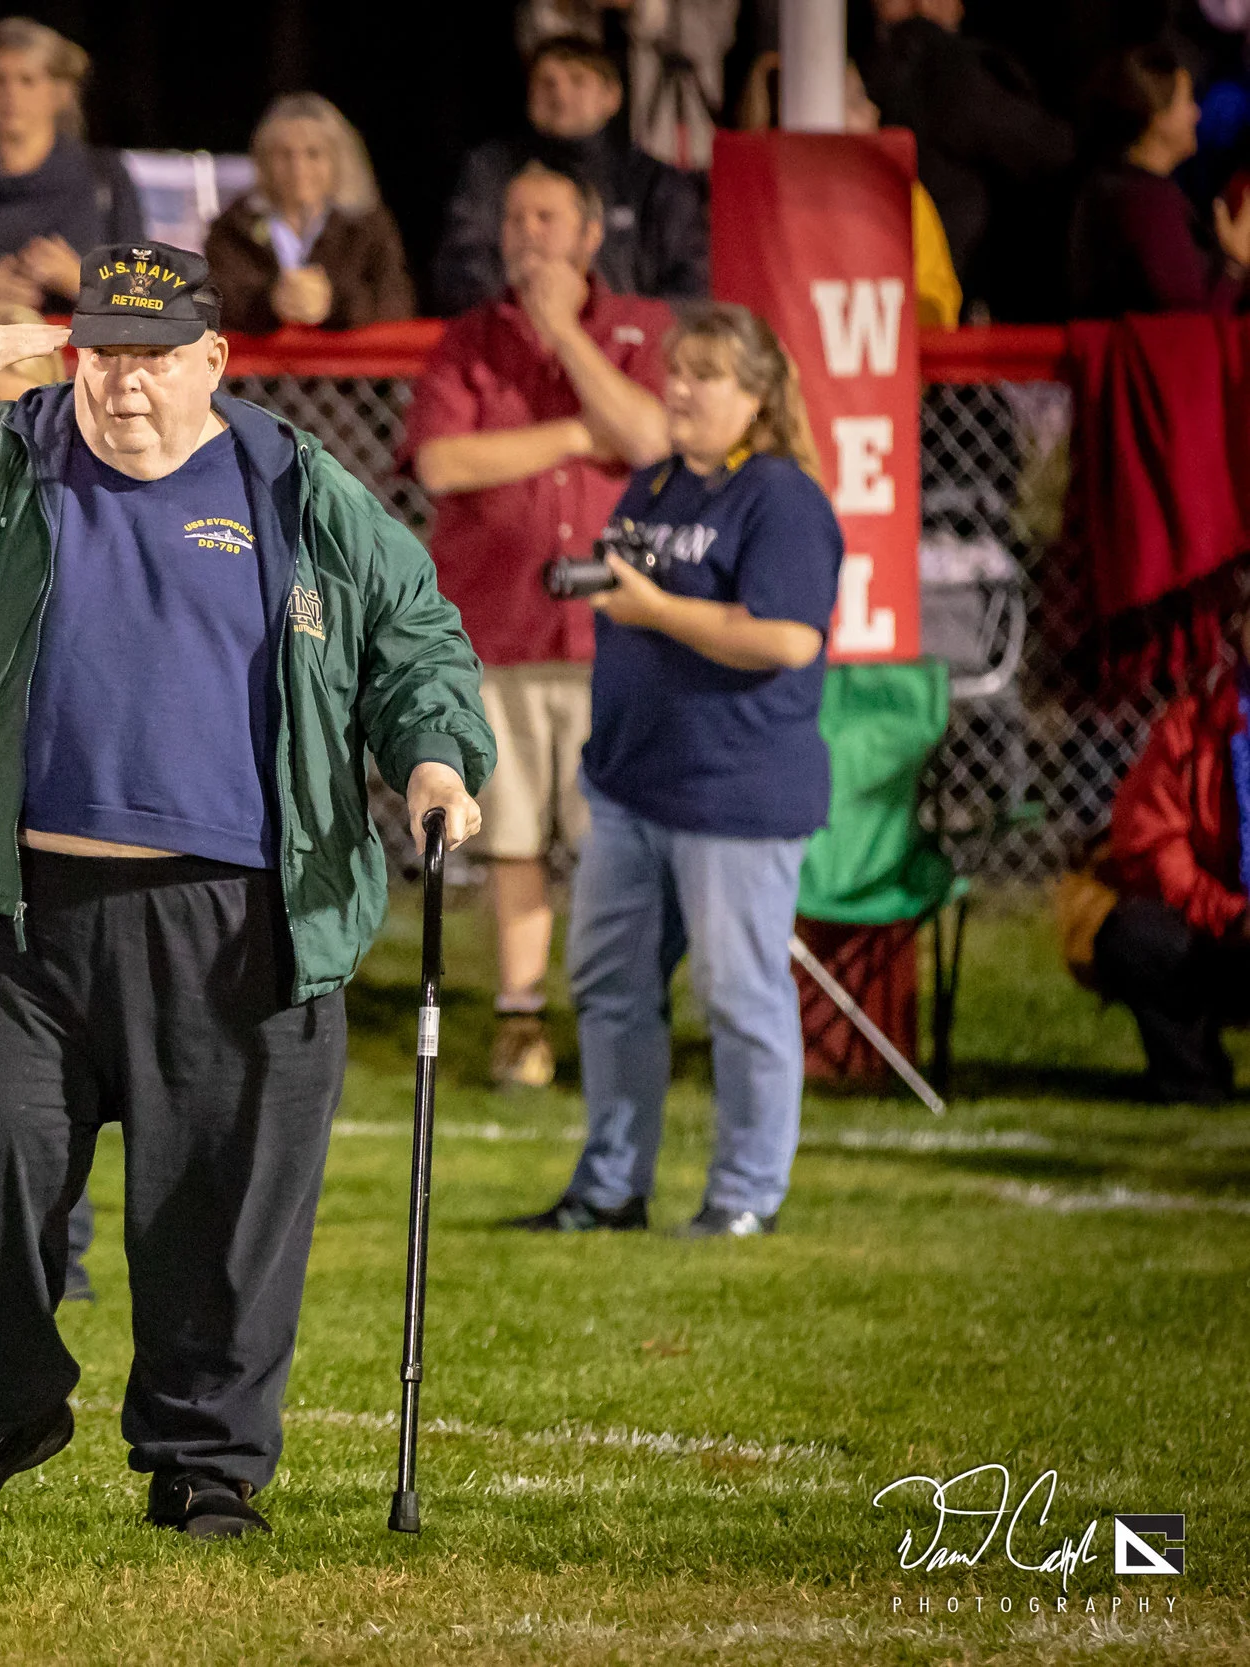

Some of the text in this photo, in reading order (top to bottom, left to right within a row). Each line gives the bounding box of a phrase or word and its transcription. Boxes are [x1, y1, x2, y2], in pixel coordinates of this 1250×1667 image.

[98, 260, 187, 289] U.S. NAVY
[111, 294, 165, 311] RETIRED
[183, 519, 206, 532] USS
[197, 538, 241, 555] DD-789
